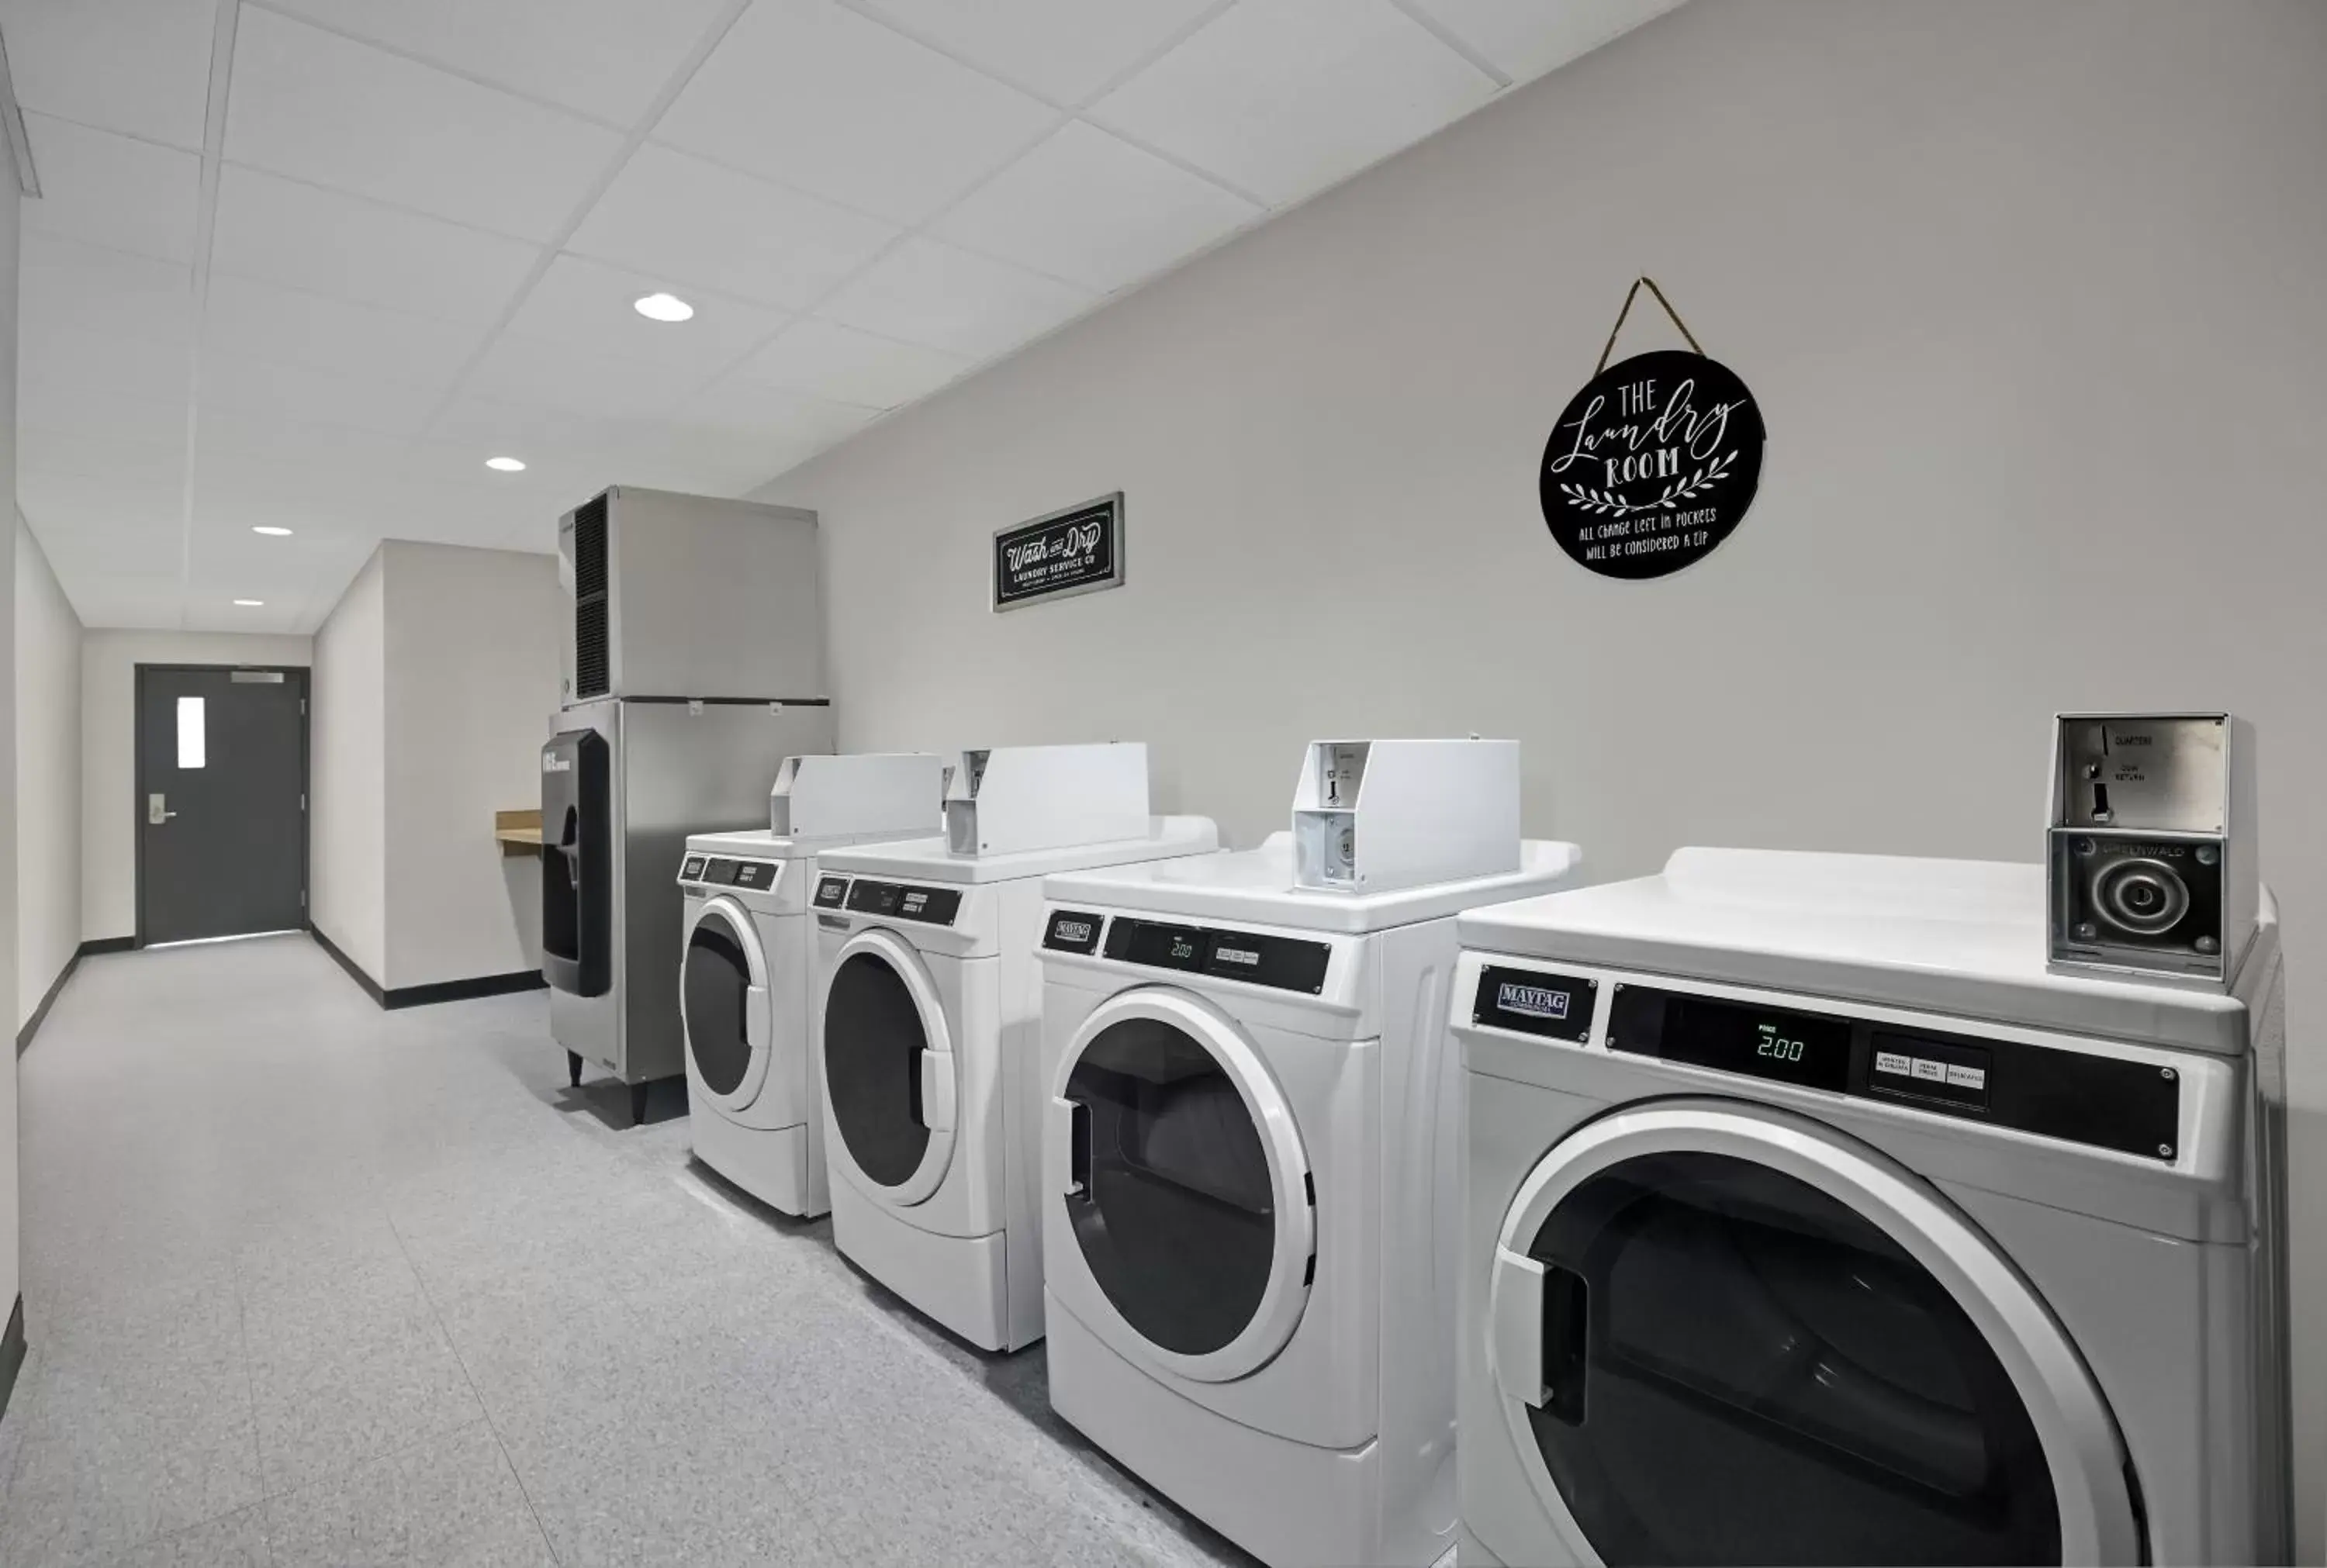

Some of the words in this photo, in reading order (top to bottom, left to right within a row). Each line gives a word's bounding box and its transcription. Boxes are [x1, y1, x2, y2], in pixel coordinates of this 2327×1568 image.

[1617, 378, 1658, 417] THE
[1551, 378, 1747, 473] Laundry
[1603, 446, 1679, 489] ROOM
[1578, 527, 1595, 541] ALL
[1597, 520, 1630, 539] CHANGE
[1007, 536, 1049, 572] Wash
[1062, 522, 1101, 558] Dry
[1585, 544, 1607, 561] WILL
[1610, 542, 1623, 558] BE
[1624, 534, 1680, 556] CONSIDERED
[1683, 534, 1690, 548] A
[1014, 566, 1048, 583] LAUNDRY
[1049, 557, 1083, 574] SERVICE
[1501, 985, 1565, 1010] MAYTAG
[1757, 1035, 1804, 1062] 2.00
